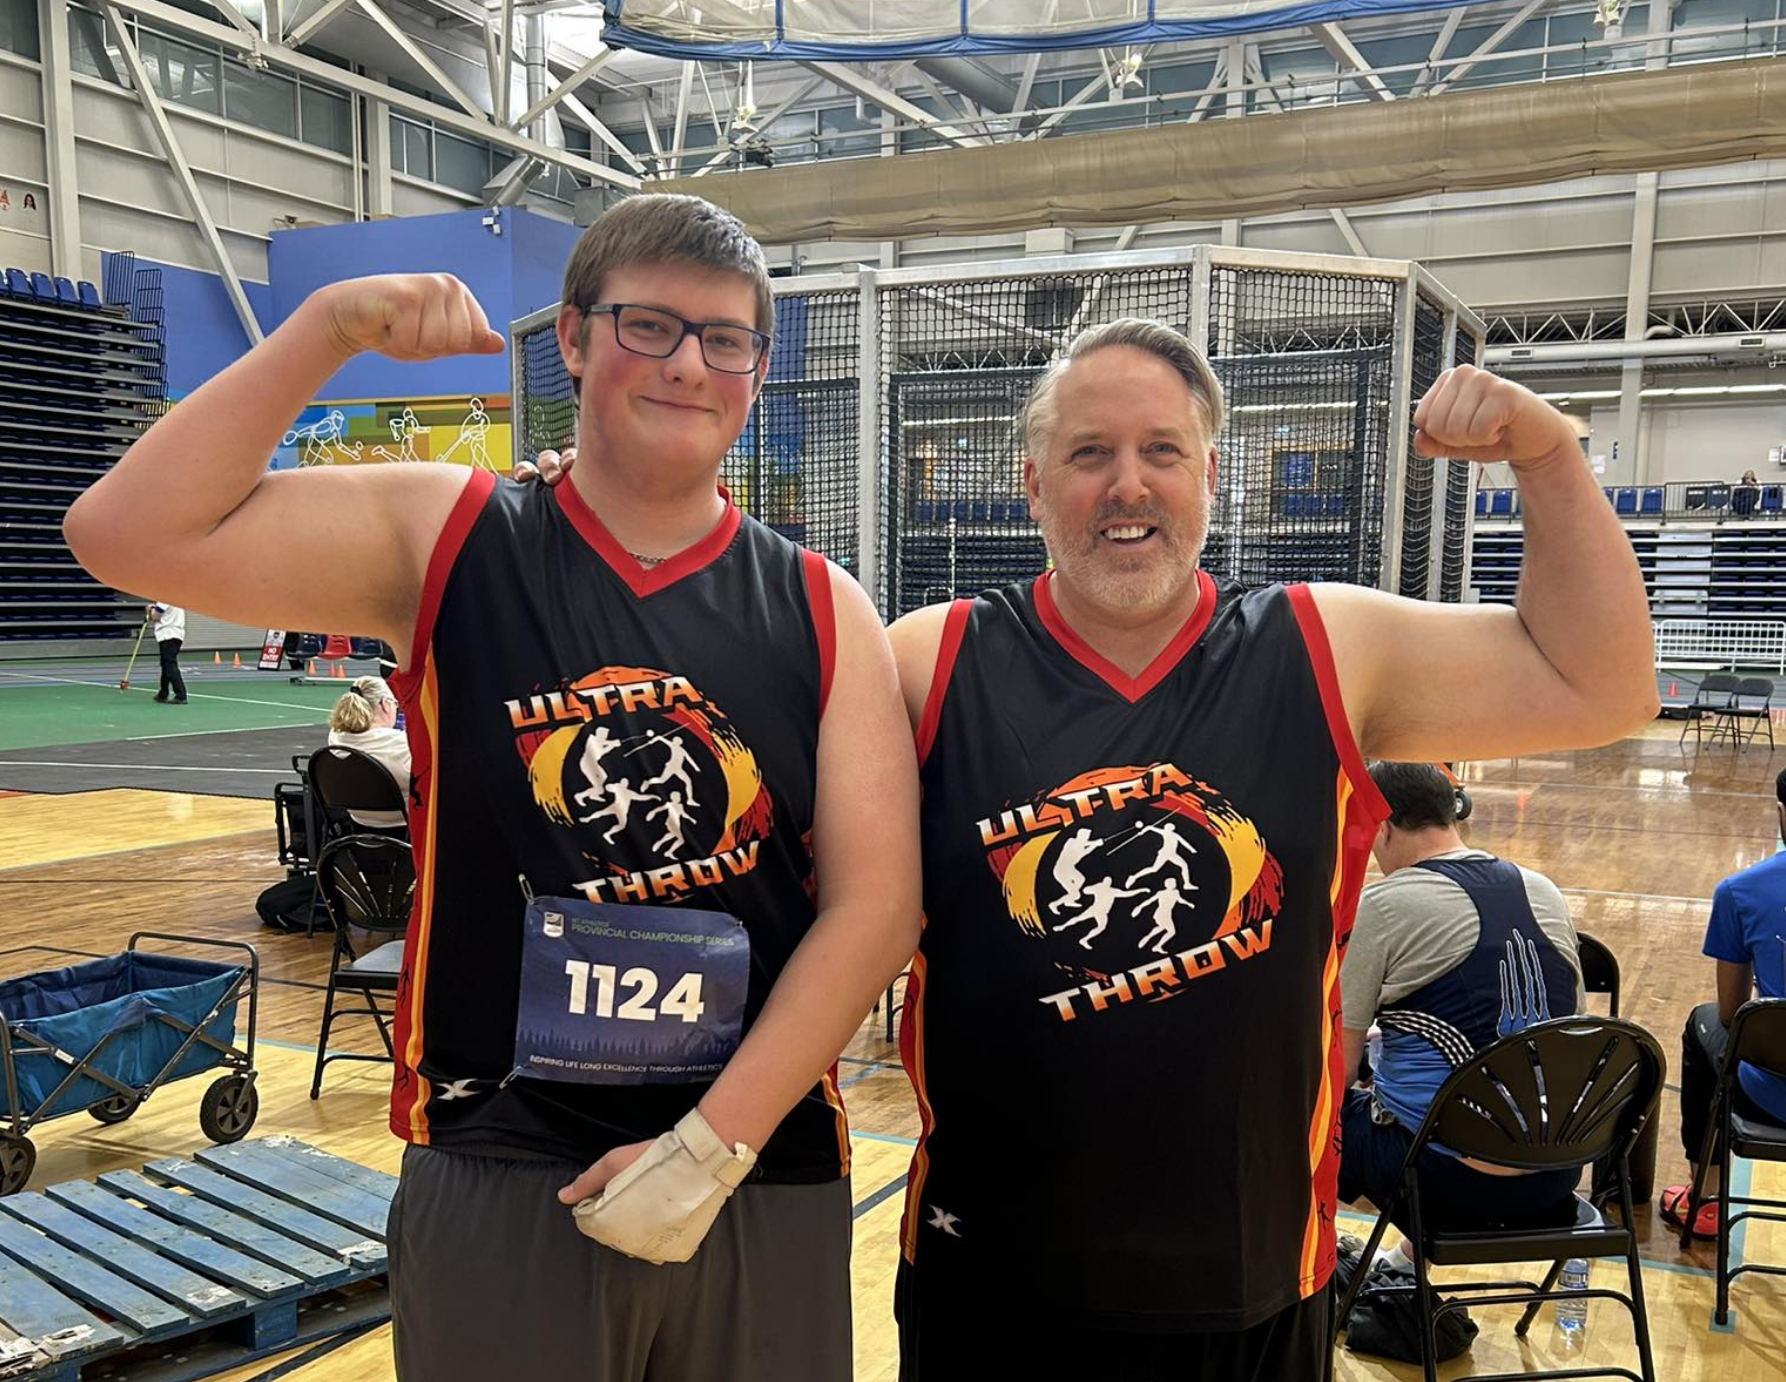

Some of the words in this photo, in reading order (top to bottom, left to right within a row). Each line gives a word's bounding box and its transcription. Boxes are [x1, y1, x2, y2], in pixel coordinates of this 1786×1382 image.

[504, 676, 703, 729] ULTRA
[976, 763, 1193, 846] ULTRA
[572, 840, 760, 904] THROW
[571, 924, 627, 939] PROVINCIAL
[629, 930, 704, 944] CHAMPIONSHIP
[705, 935, 735, 947] SERIES
[565, 959, 704, 1023] 1124
[1038, 918, 1272, 1021] THROW
[565, 1060, 579, 1069] LIFE
[580, 1062, 602, 1071] LONG
[603, 1063, 647, 1073] EXCELLENCE
[649, 1064, 685, 1073] THROUGH
